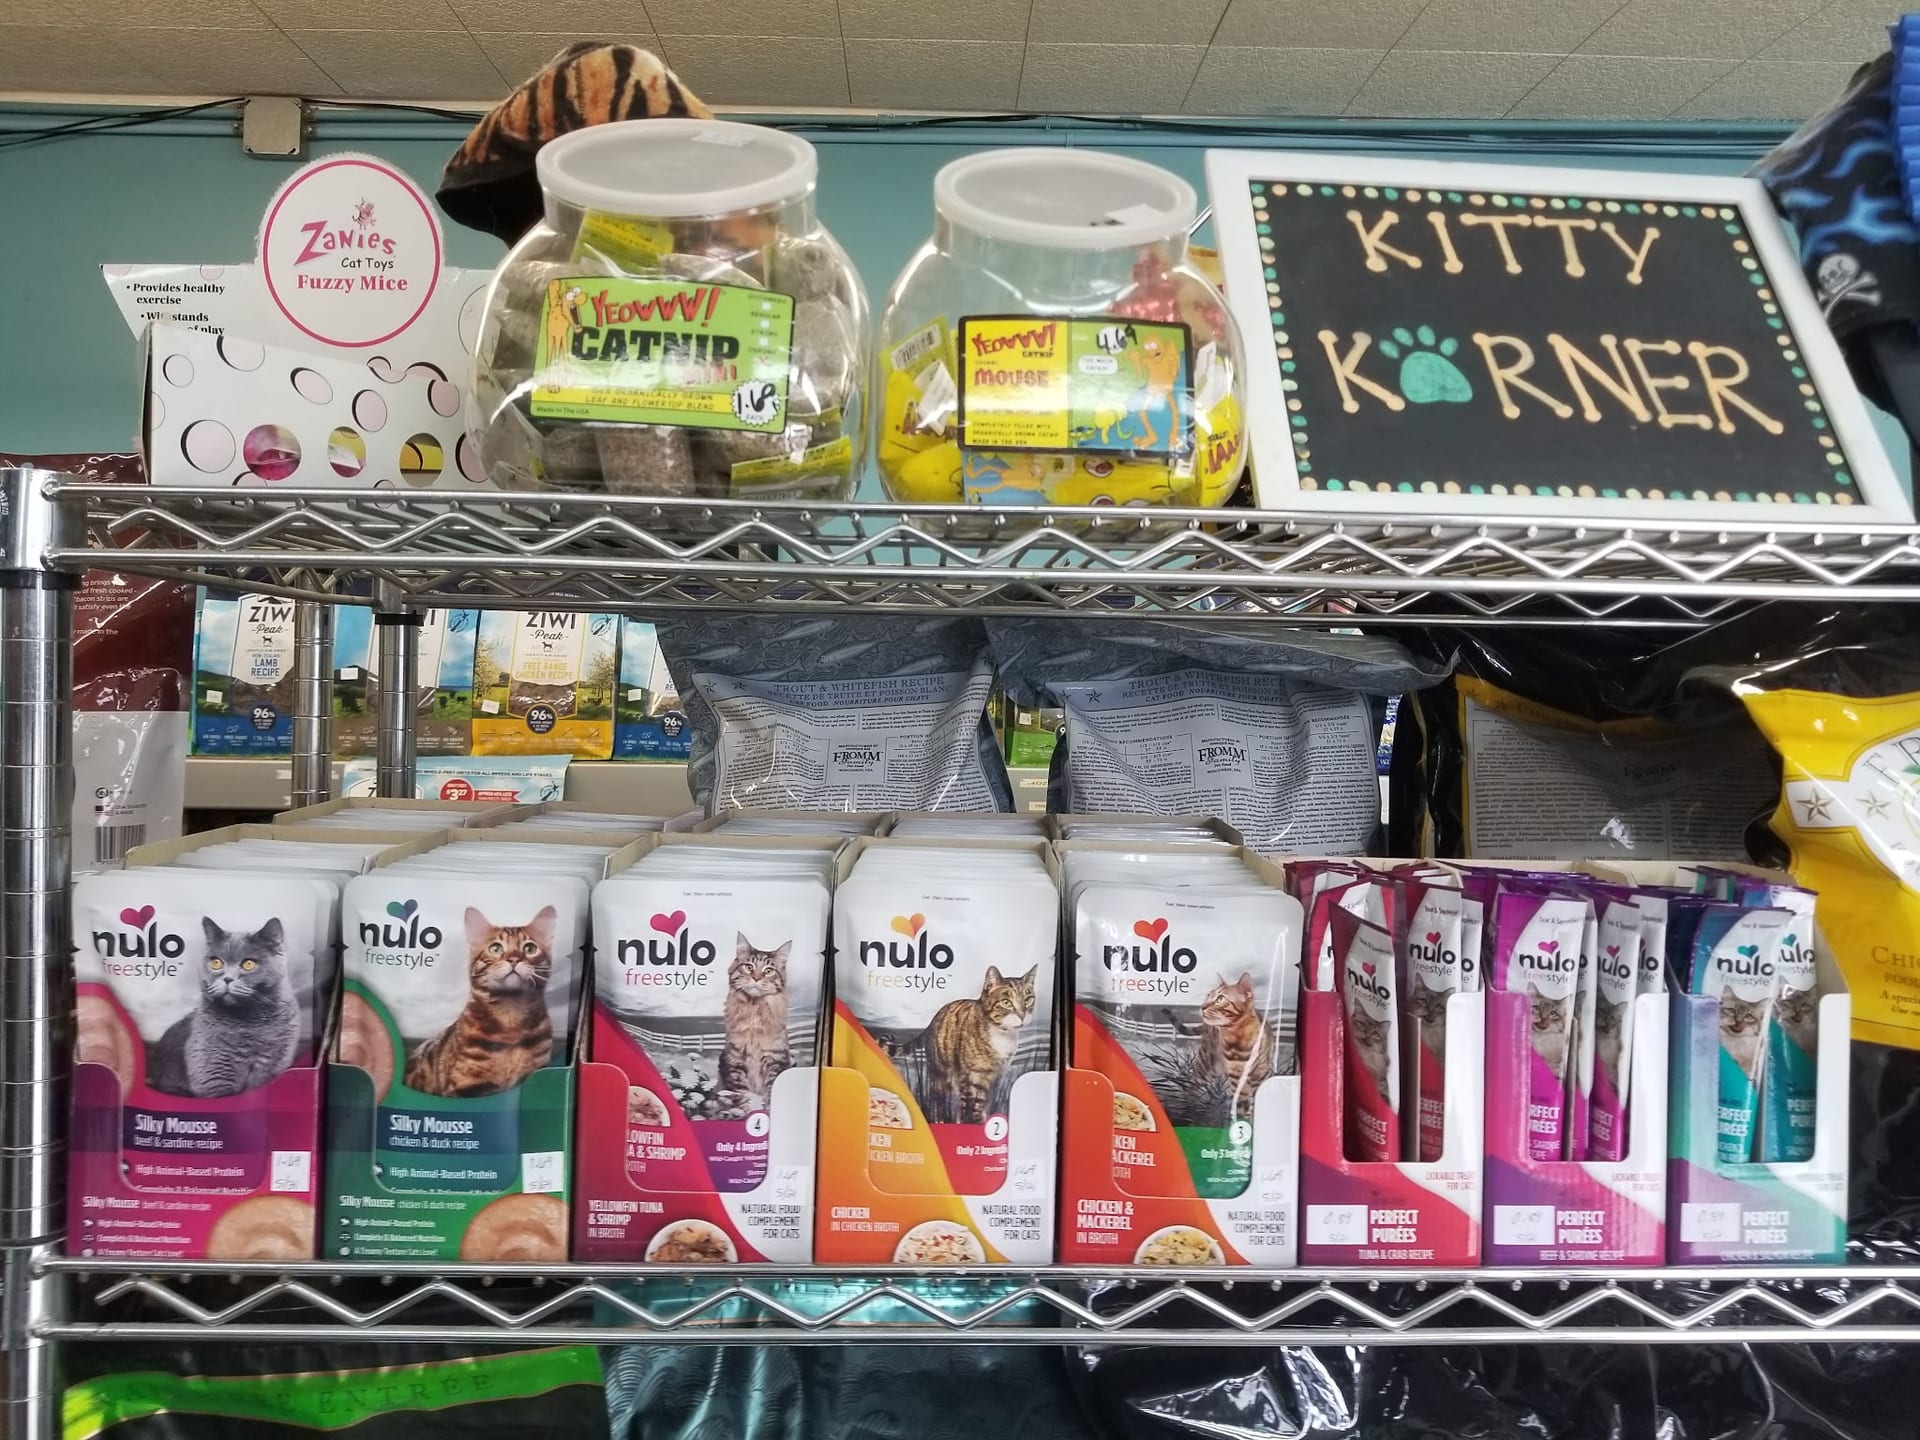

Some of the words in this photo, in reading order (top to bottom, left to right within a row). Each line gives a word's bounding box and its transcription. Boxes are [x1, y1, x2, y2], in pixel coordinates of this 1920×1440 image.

[293, 220, 398, 266] Zanies
[1346, 209, 1660, 284] KITTY
[341, 257, 362, 269] Cat
[365, 257, 394, 273] Toys
[133, 283, 181, 293] Provides
[183, 283, 225, 295] healthy
[297, 274, 355, 294] Fuzzy
[360, 275, 408, 291] Mice
[136, 295, 182, 305] exercise
[591, 287, 723, 328] YEOWWW!
[571, 325, 740, 365] CATNIP
[971, 323, 1057, 357] YEOWWW!
[613, 397, 629, 405] AND
[78, 603, 100, 611] satisfy
[526, 612, 577, 630] ZIWI
[256, 623, 284, 634] Peak
[534, 629, 564, 641] Peak
[254, 658, 278, 667] LAMB
[251, 667, 280, 677] RECIPE
[774, 683, 816, 693] TROUT
[831, 680, 897, 691] WHITEFISH
[901, 676, 945, 687] RECIPE
[1128, 676, 1169, 690] TROUT
[1185, 671, 1250, 686] WHITEFISH
[812, 692, 825, 700] DE
[829, 691, 862, 700] TRUITE
[879, 687, 918, 697] POISSON
[1122, 686, 1166, 699] RECETTE
[1168, 684, 1180, 692] DE
[1145, 694, 1161, 703] CAT
[1162, 690, 1184, 700] FOOD
[806, 700, 829, 708] FOOD
[253, 708, 275, 719] 96%
[531, 709, 553, 720] 96%
[833, 751, 881, 763] FROMM
[1197, 745, 1247, 762] FROMM
[360, 914, 443, 950] nulo
[92, 921, 186, 959] nulo
[617, 927, 717, 967] nulo
[860, 930, 954, 970] nulo
[1103, 935, 1197, 974] nulo
[1409, 943, 1456, 965] nulo
[365, 948, 434, 970] freestyle
[1519, 951, 1575, 972] nulo
[1717, 955, 1775, 976] nulo
[103, 959, 179, 981] freestyle
[1412, 961, 1453, 976] freestyle
[625, 968, 708, 990] freestyle
[866, 970, 947, 993] freestyle
[1347, 968, 1390, 1000] nulo
[1111, 976, 1190, 997] freestyle
[135, 1113, 164, 1135] Silky
[165, 1116, 217, 1134] Mousse
[389, 1114, 421, 1135] Silky
[423, 1116, 473, 1134] Mousse
[993, 1121, 1000, 1136] 2
[1238, 1125, 1245, 1140] 3
[134, 1135, 154, 1147] beef
[162, 1136, 195, 1148] sardine
[196, 1138, 223, 1150] recipe
[389, 1136, 420, 1148] chicken
[430, 1137, 451, 1149] duck
[452, 1138, 479, 1150] recipe
[716, 1142, 733, 1153] Only
[734, 1142, 741, 1152] 4
[1533, 1139, 1560, 1150] SARDINE
[636, 1147, 644, 1159] &
[645, 1146, 686, 1161] SHRIMP
[956, 1145, 974, 1156] Only
[1201, 1148, 1218, 1160] Only
[895, 1152, 924, 1164] BROTH
[135, 1163, 155, 1176] High
[156, 1165, 212, 1177] Animal-Based
[214, 1167, 245, 1177] Protein
[389, 1166, 409, 1178] High
[410, 1168, 466, 1179] Animal-Based
[467, 1169, 498, 1180] Protein
[83, 1195, 105, 1209] Silky
[106, 1197, 141, 1209] Mousse
[339, 1195, 362, 1208] Silky
[362, 1196, 395, 1208] Mousse
[588, 1199, 638, 1213] YELLOWFIN
[640, 1201, 664, 1214] TUNA
[1077, 1200, 1123, 1214] CHICKEN
[1125, 1201, 1134, 1214] &
[741, 1204, 778, 1214] NATURAL
[779, 1204, 800, 1214] FOOD
[831, 1206, 870, 1218] CHICKEN
[982, 1204, 1019, 1215] NATURAL
[1020, 1204, 1041, 1215] FOOD
[1228, 1211, 1263, 1221] NATURAL
[1264, 1211, 1286, 1221] FOOD
[587, 1214, 596, 1224] &
[598, 1214, 631, 1226] SHRIMP
[748, 1216, 800, 1226] COMPLEMENT
[989, 1217, 1041, 1228] COMPLEMENT
[1077, 1215, 1132, 1230] MACKEREL
[1370, 1209, 1420, 1224] PERFECT
[1556, 1211, 1605, 1226] PERFECT
[1743, 1211, 1790, 1226] PERFECT
[597, 1228, 625, 1239] BROTH
[762, 1229, 779, 1239] FOR
[781, 1229, 800, 1239] CATS
[841, 1222, 872, 1232] CHICKEN
[873, 1222, 899, 1233] BROTH
[1234, 1223, 1285, 1233] COMPLEMENT
[1372, 1225, 1417, 1243] PURÉES
[1004, 1230, 1019, 1240] FOR
[1021, 1230, 1041, 1240] CATS
[1077, 1232, 1086, 1243] IN
[1087, 1232, 1119, 1244] BROTH
[1249, 1235, 1264, 1245] FOR
[1266, 1235, 1285, 1245] CATS
[1558, 1226, 1604, 1244] PURÉES
[1745, 1226, 1788, 1244] PURÉES
[1358, 1249, 1379, 1259] TUNA
[1385, 1250, 1408, 1259] CRAB
[1409, 1250, 1435, 1260] RECIPE
[1540, 1250, 1560, 1261] BEEF
[1566, 1250, 1599, 1261] SARDINE
[1599, 1250, 1625, 1261] RECIPE
